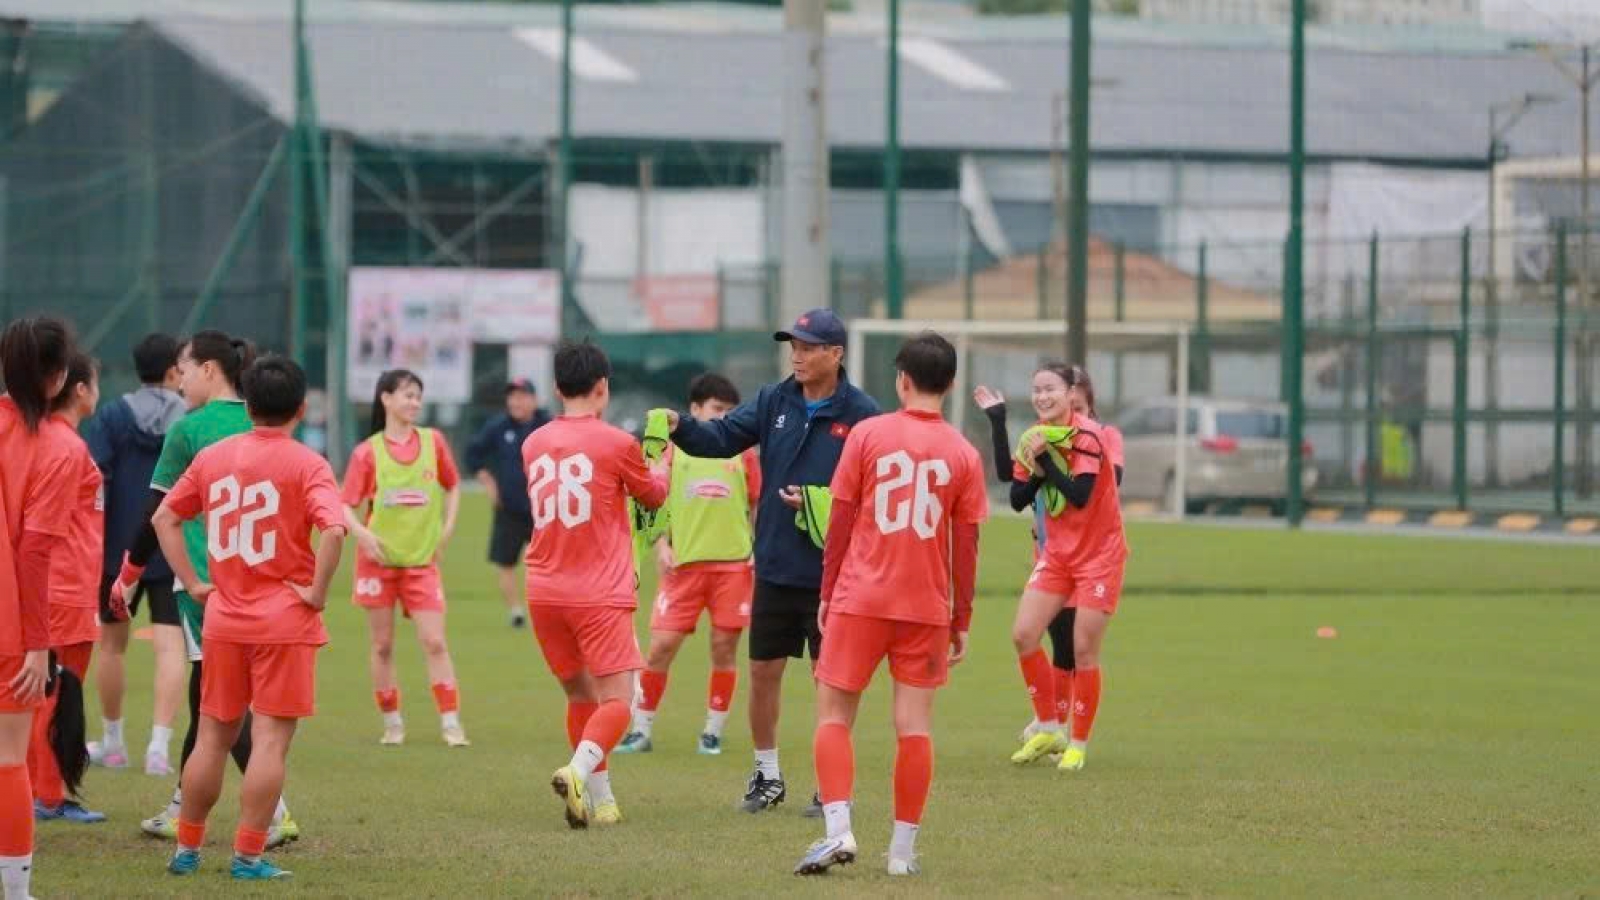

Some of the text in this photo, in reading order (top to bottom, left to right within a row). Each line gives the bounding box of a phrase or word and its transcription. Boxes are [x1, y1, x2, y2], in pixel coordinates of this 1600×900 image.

[208, 474, 280, 567] 22
[530, 453, 593, 529] 28
[875, 450, 951, 540] 26
